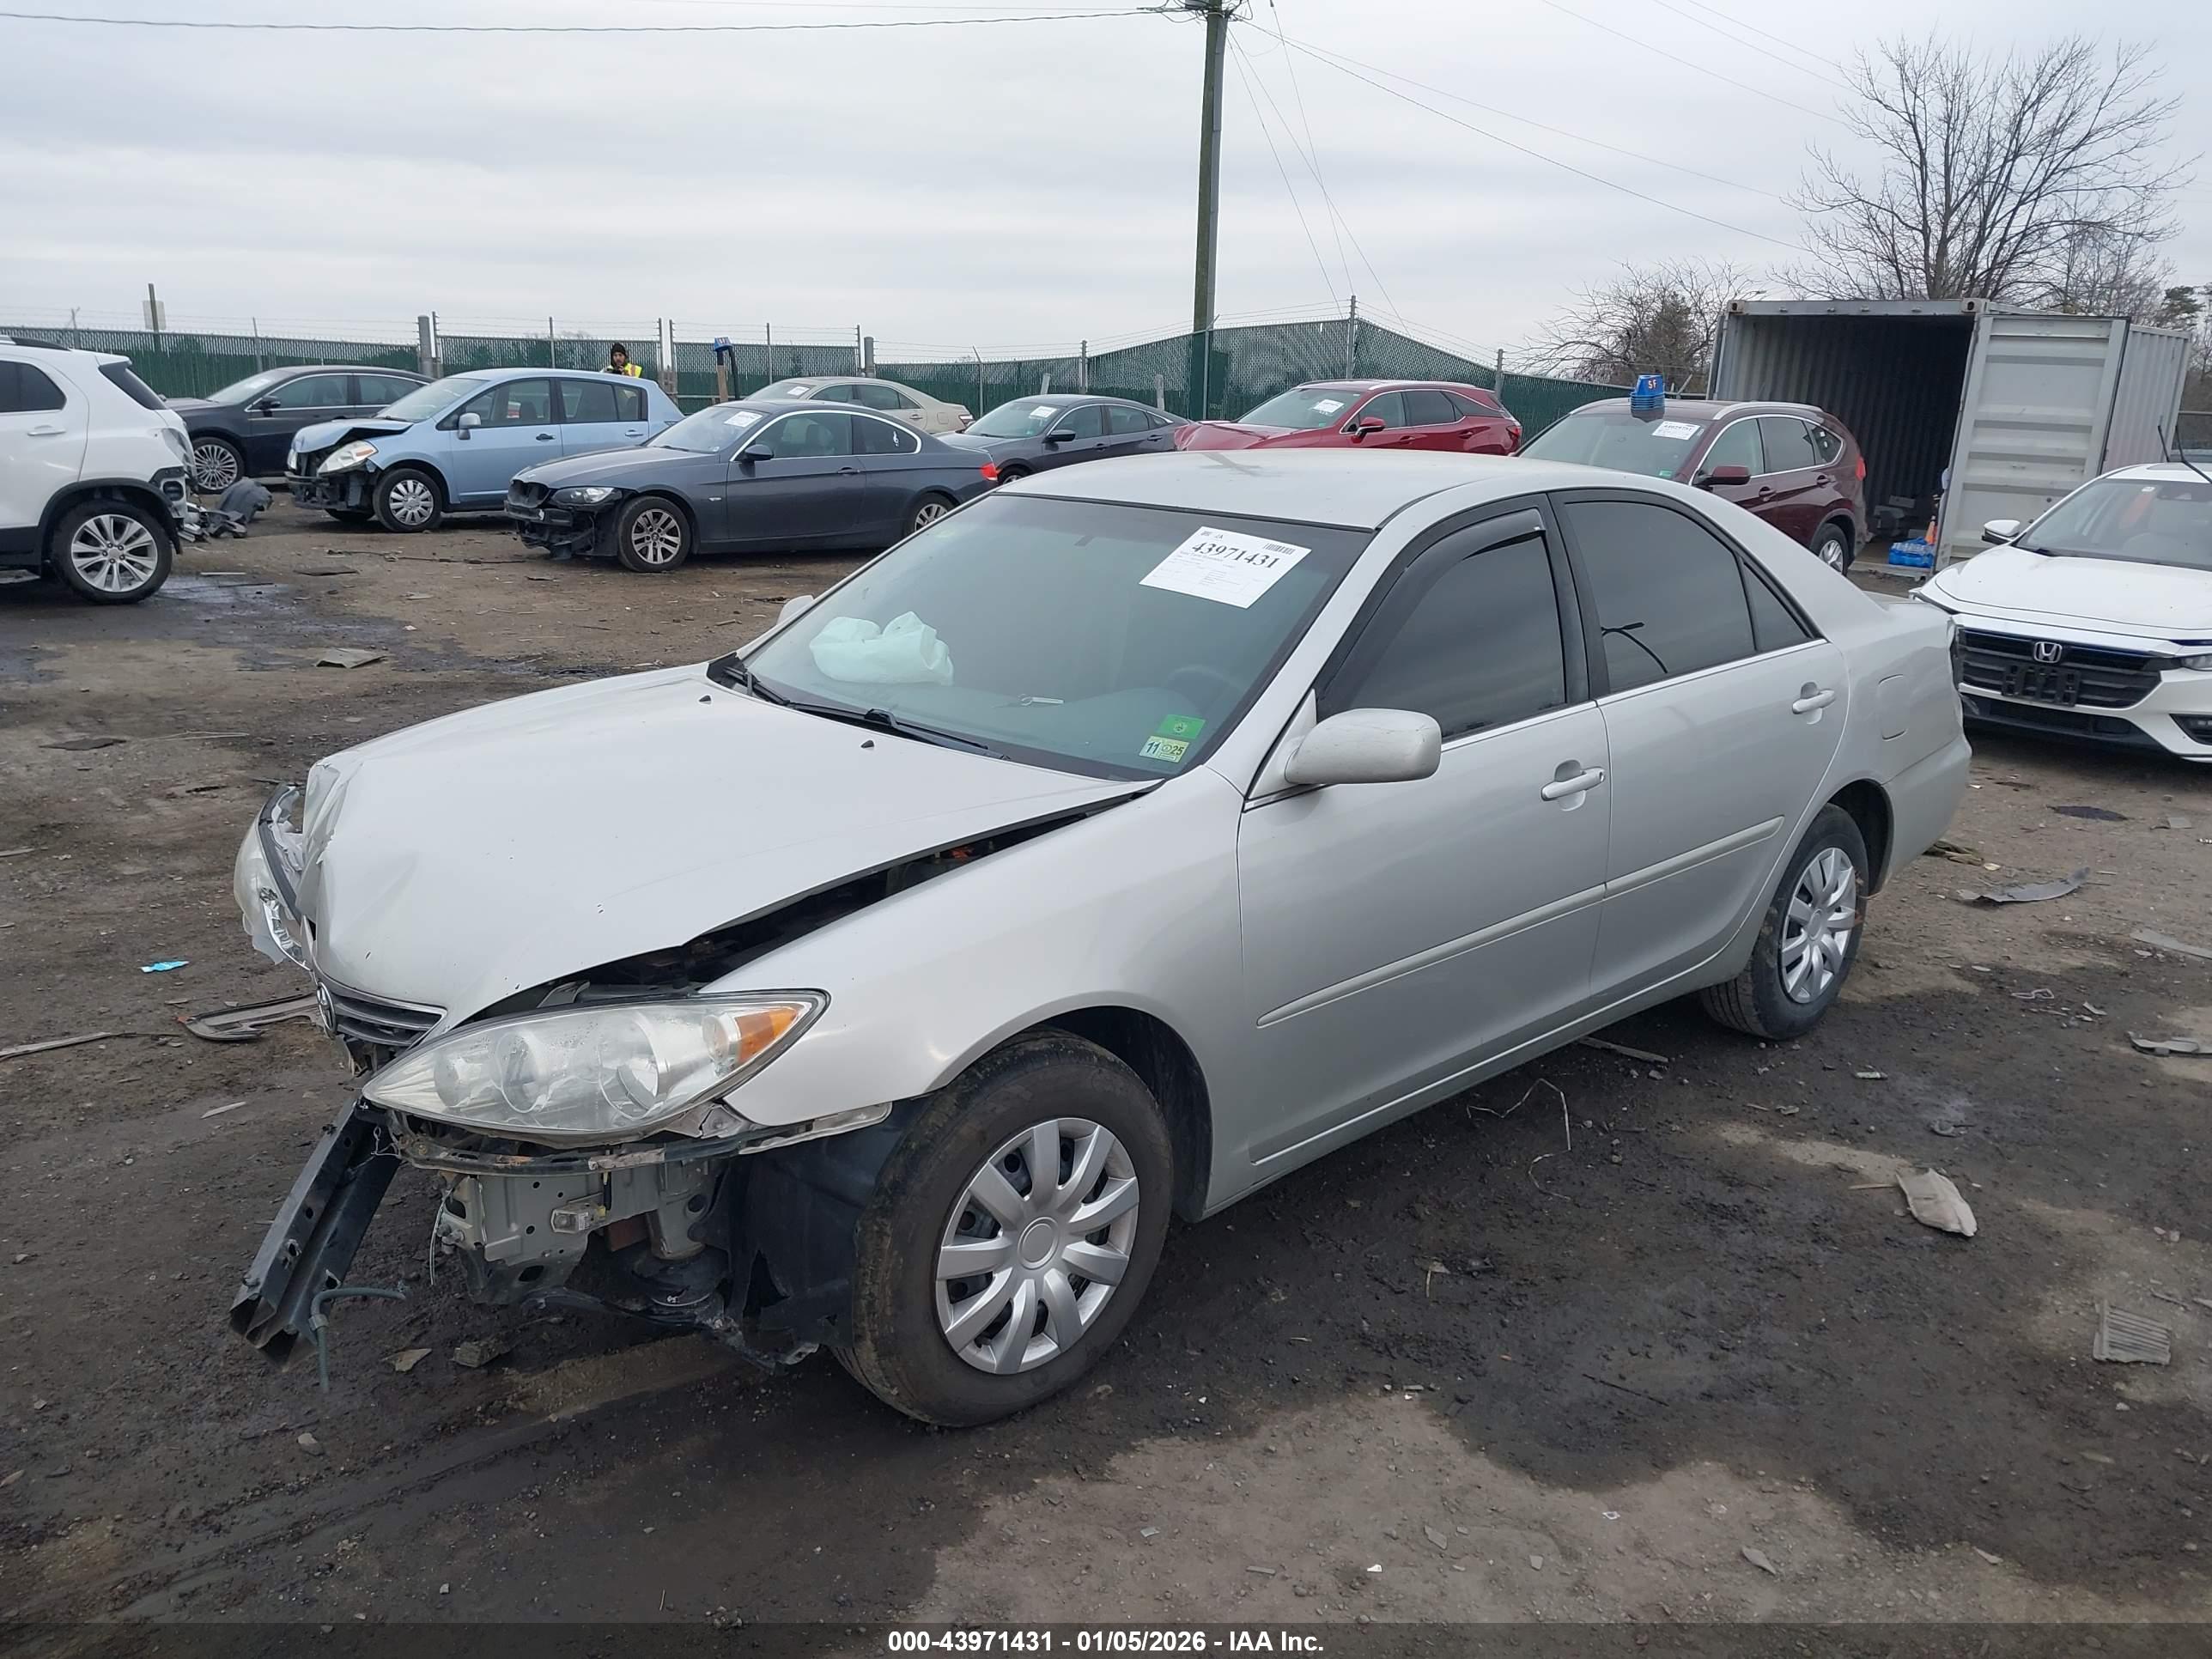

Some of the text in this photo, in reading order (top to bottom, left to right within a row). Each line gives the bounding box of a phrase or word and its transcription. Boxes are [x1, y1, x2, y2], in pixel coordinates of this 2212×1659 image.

[1192, 542, 1280, 568] 43971431
[1146, 741, 1184, 756] 11 25
